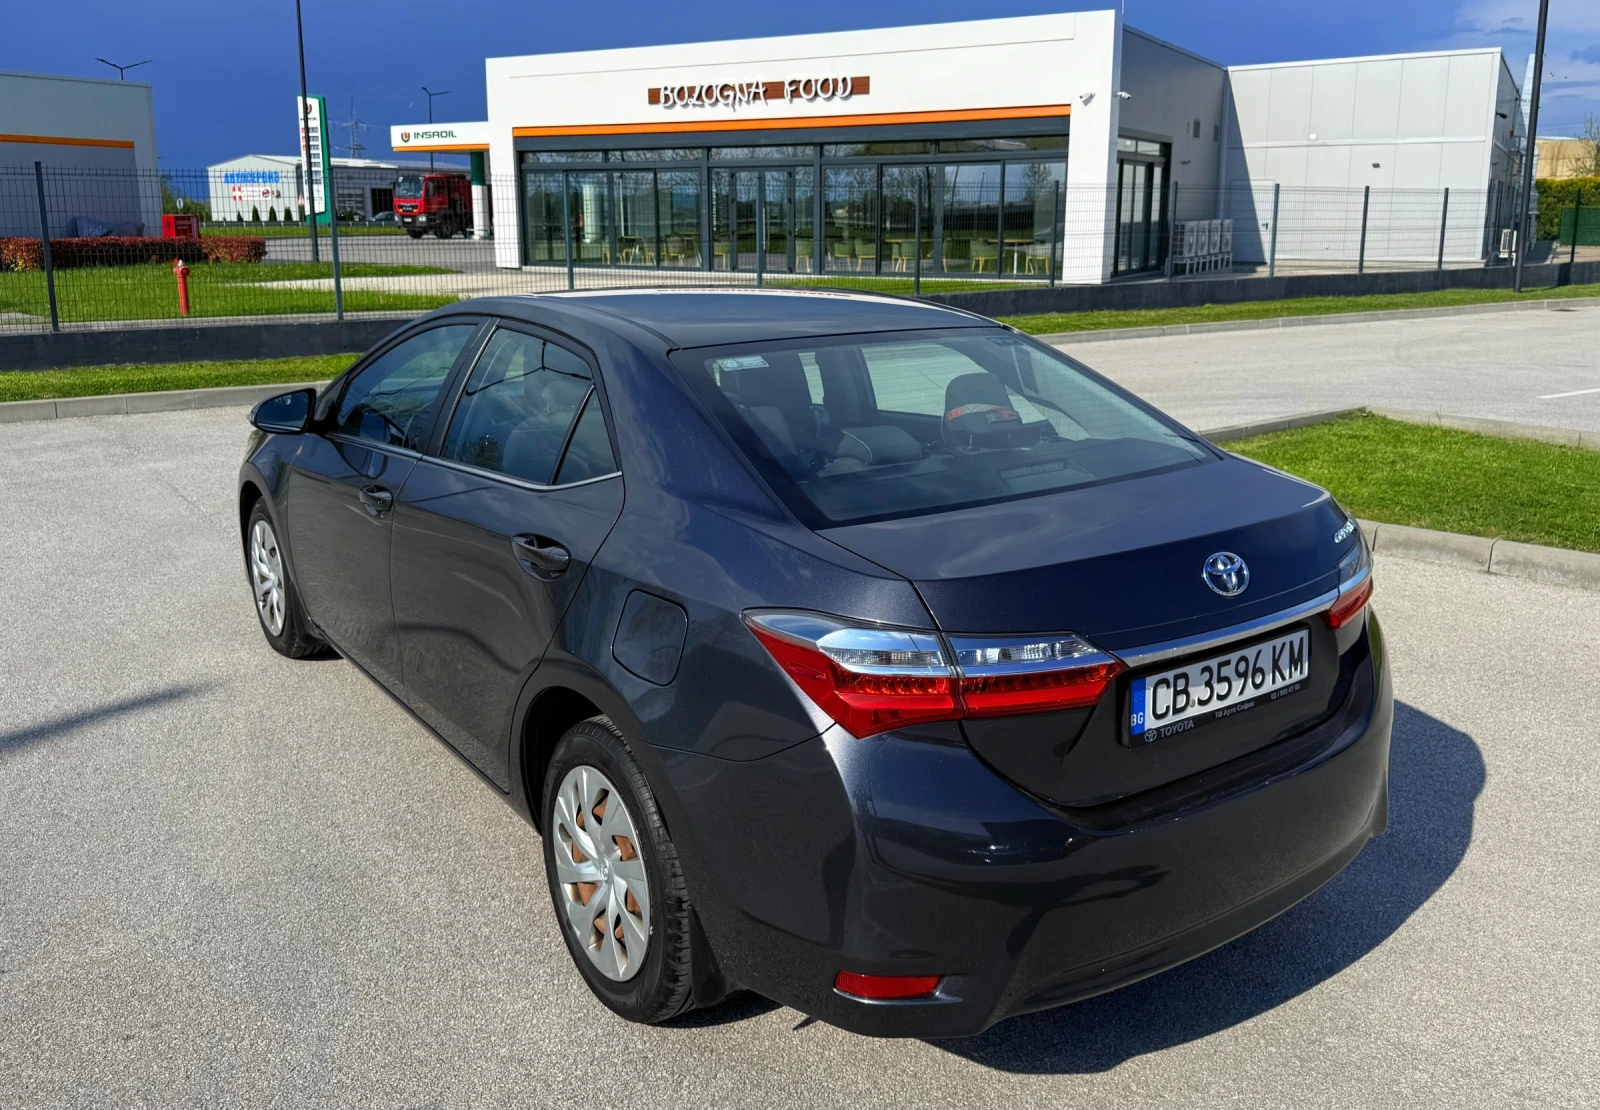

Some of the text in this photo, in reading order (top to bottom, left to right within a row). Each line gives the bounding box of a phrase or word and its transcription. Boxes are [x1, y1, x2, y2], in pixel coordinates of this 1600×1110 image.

[660, 73, 853, 108] BOLOGNA FOOD
[413, 130, 457, 139] INSAOIL
[1130, 712, 1144, 727] BG
[1160, 719, 1194, 738] TOYOTA
